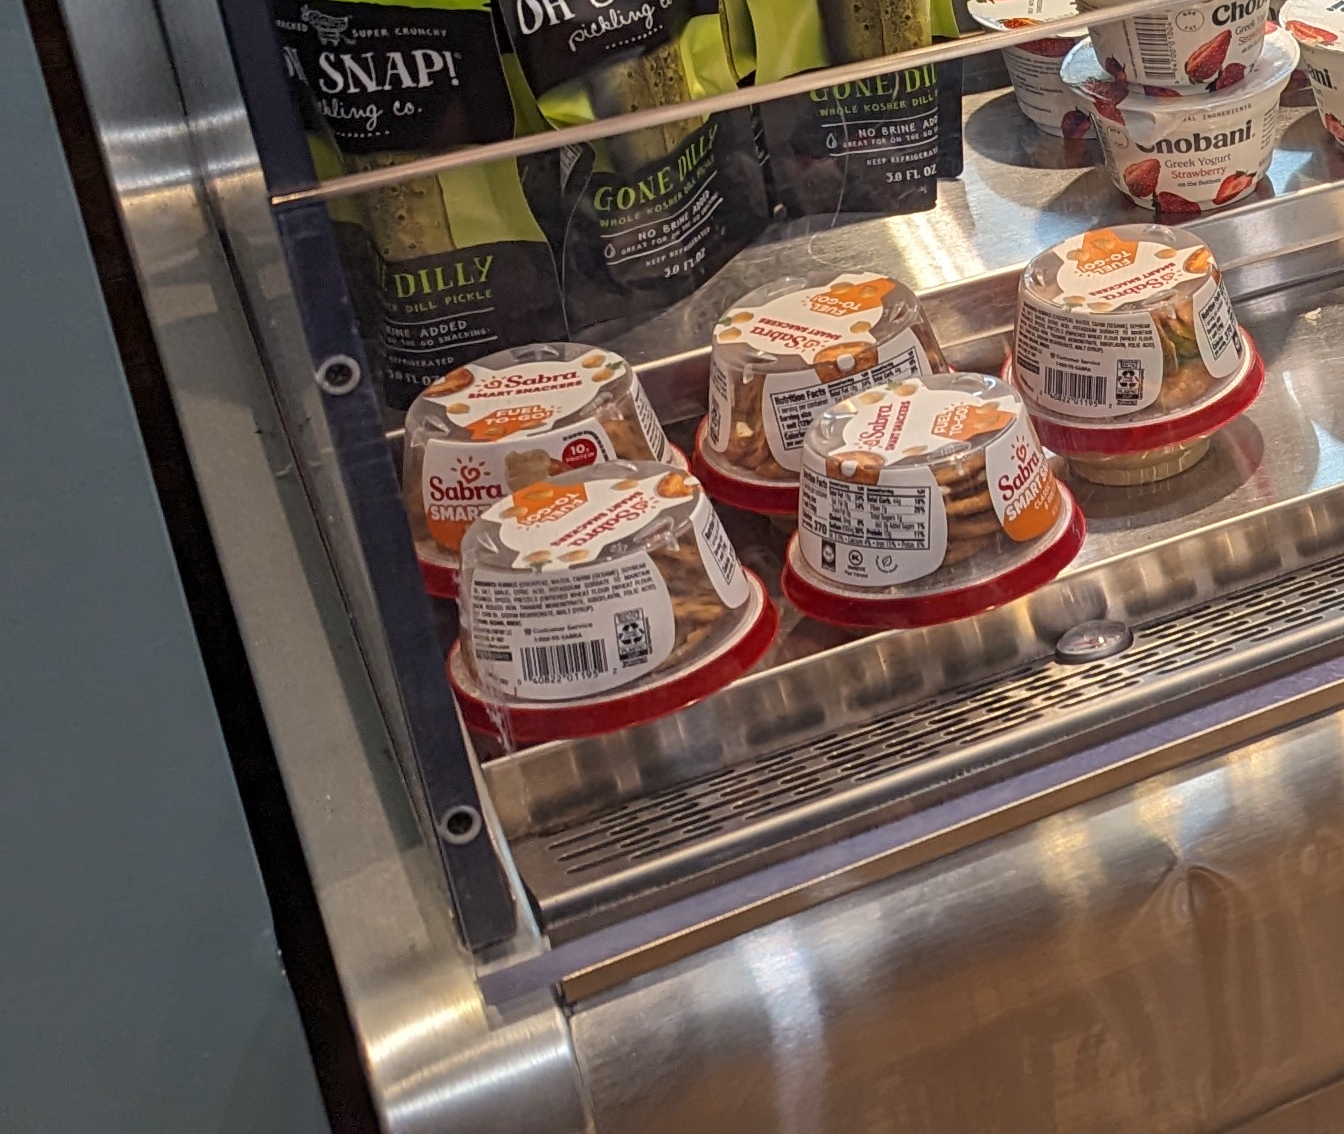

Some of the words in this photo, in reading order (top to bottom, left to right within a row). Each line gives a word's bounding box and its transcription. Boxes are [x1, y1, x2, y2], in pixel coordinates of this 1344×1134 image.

[352, 27, 389, 38] SUPER
[569, 3, 656, 51] pickling
[318, 49, 460, 94] SNAP!
[820, 105, 857, 116] WHOLE
[864, 100, 906, 112] KOSHER
[858, 128, 875, 138] NO
[882, 122, 915, 135] BRINE
[842, 139, 868, 148] GREAT
[593, 166, 674, 212] GONE
[678, 123, 718, 182] DILLY
[1165, 159, 1195, 169] Greek
[1198, 153, 1231, 166] Yogurt
[906, 169, 921, 181] FL
[923, 164, 937, 178] OZ
[1171, 166, 1227, 179] Strawberry
[600, 213, 640, 228] WHOLE
[638, 229, 656, 241] NO
[662, 209, 690, 234] BRINE
[620, 242, 648, 256] GREAT
[1095, 259, 1130, 274] FUEL
[1141, 262, 1176, 279] SMART
[393, 255, 494, 299] DILLY
[1100, 279, 1164, 301] Sabra
[405, 302, 437, 314] DILL
[445, 289, 492, 306] PICKLE
[810, 302, 847, 316] FUEL
[813, 294, 861, 311] TO-GO!
[420, 319, 467, 338] ADDED
[750, 325, 806, 349] Sabra
[503, 371, 577, 389] Sabra
[468, 389, 511, 399] SMART
[515, 380, 582, 396] SNACKERS
[774, 393, 805, 405] Nutrition
[806, 388, 826, 399] Facts
[496, 405, 545, 417] FUEL
[860, 403, 893, 439] Sabra
[565, 452, 595, 462] PROTEIN
[998, 452, 1039, 501] Sabra
[430, 475, 503, 501] Sabra
[1006, 472, 1042, 521] SMART
[570, 509, 640, 546] Sabra
[814, 519, 827, 535] 370
